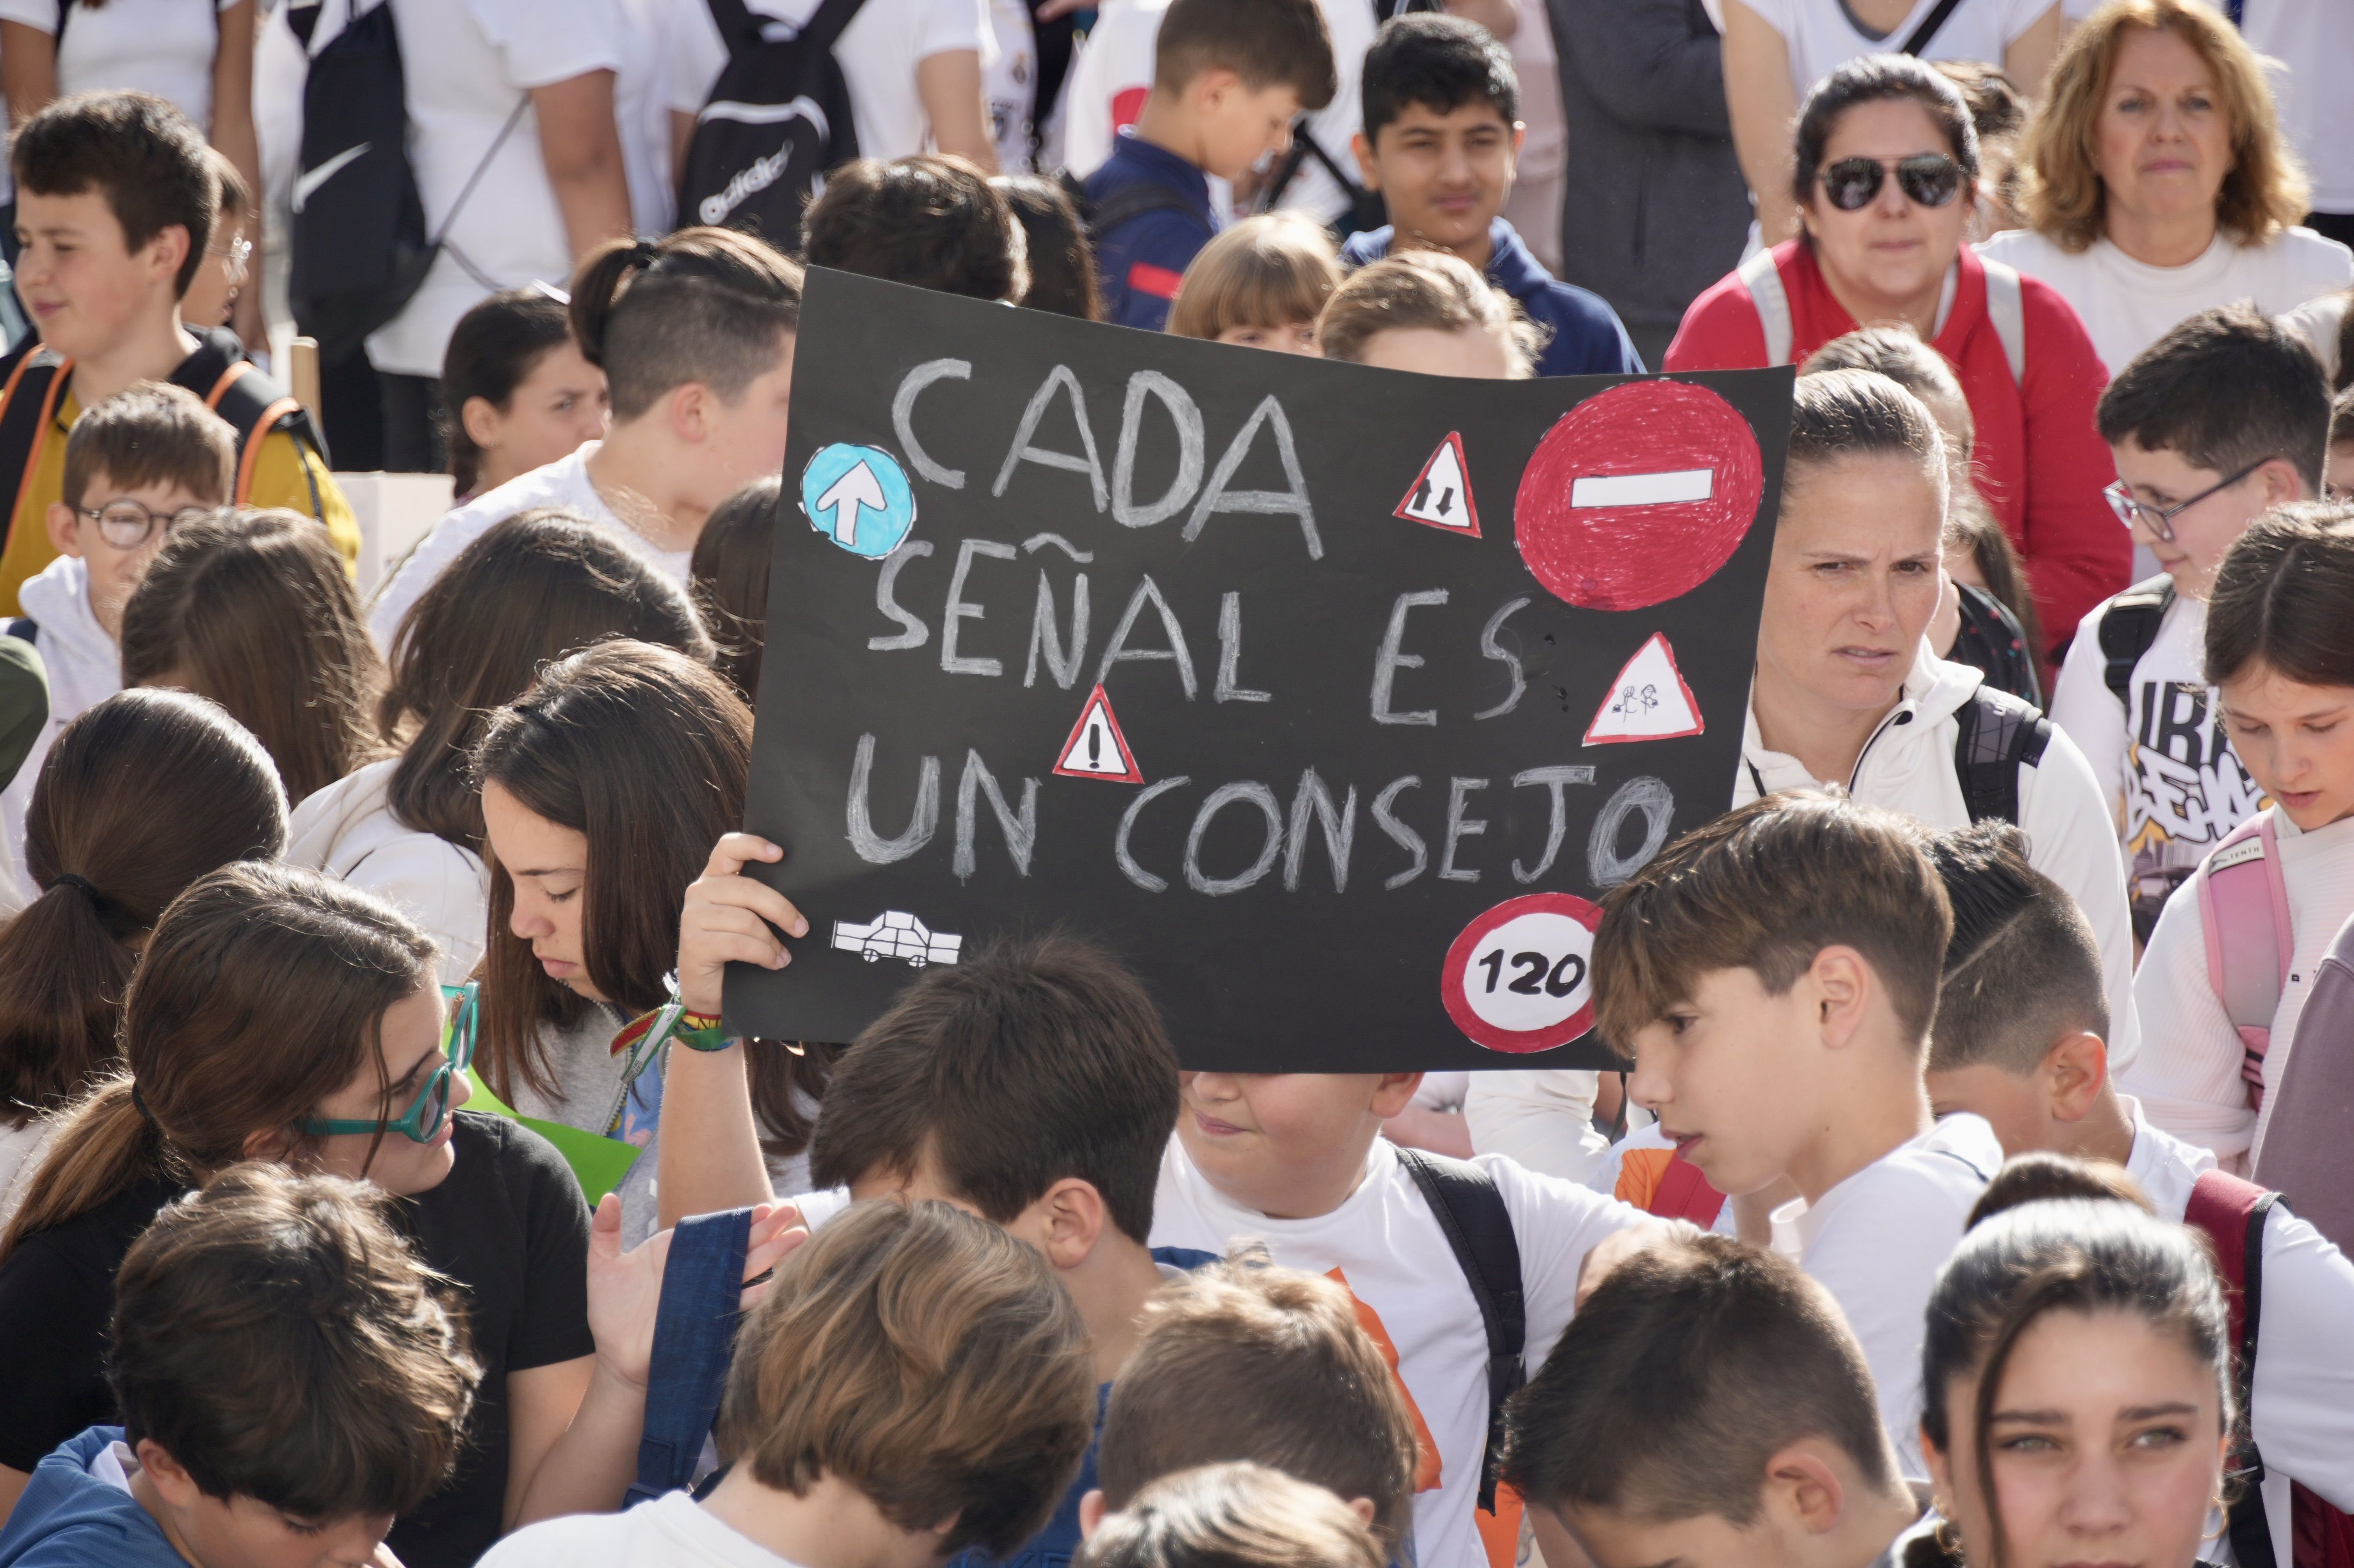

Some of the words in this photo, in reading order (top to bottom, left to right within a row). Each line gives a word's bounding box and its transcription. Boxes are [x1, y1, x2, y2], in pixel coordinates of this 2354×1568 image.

[892, 358, 1324, 560] CADA
[868, 532, 1272, 703] SEÑAL
[1370, 588, 1531, 725] ES
[845, 732, 1043, 886] UN
[1115, 765, 1674, 897] CONSEJO
[2230, 846, 2259, 859] TENTH
[1478, 948, 1586, 998] 120
